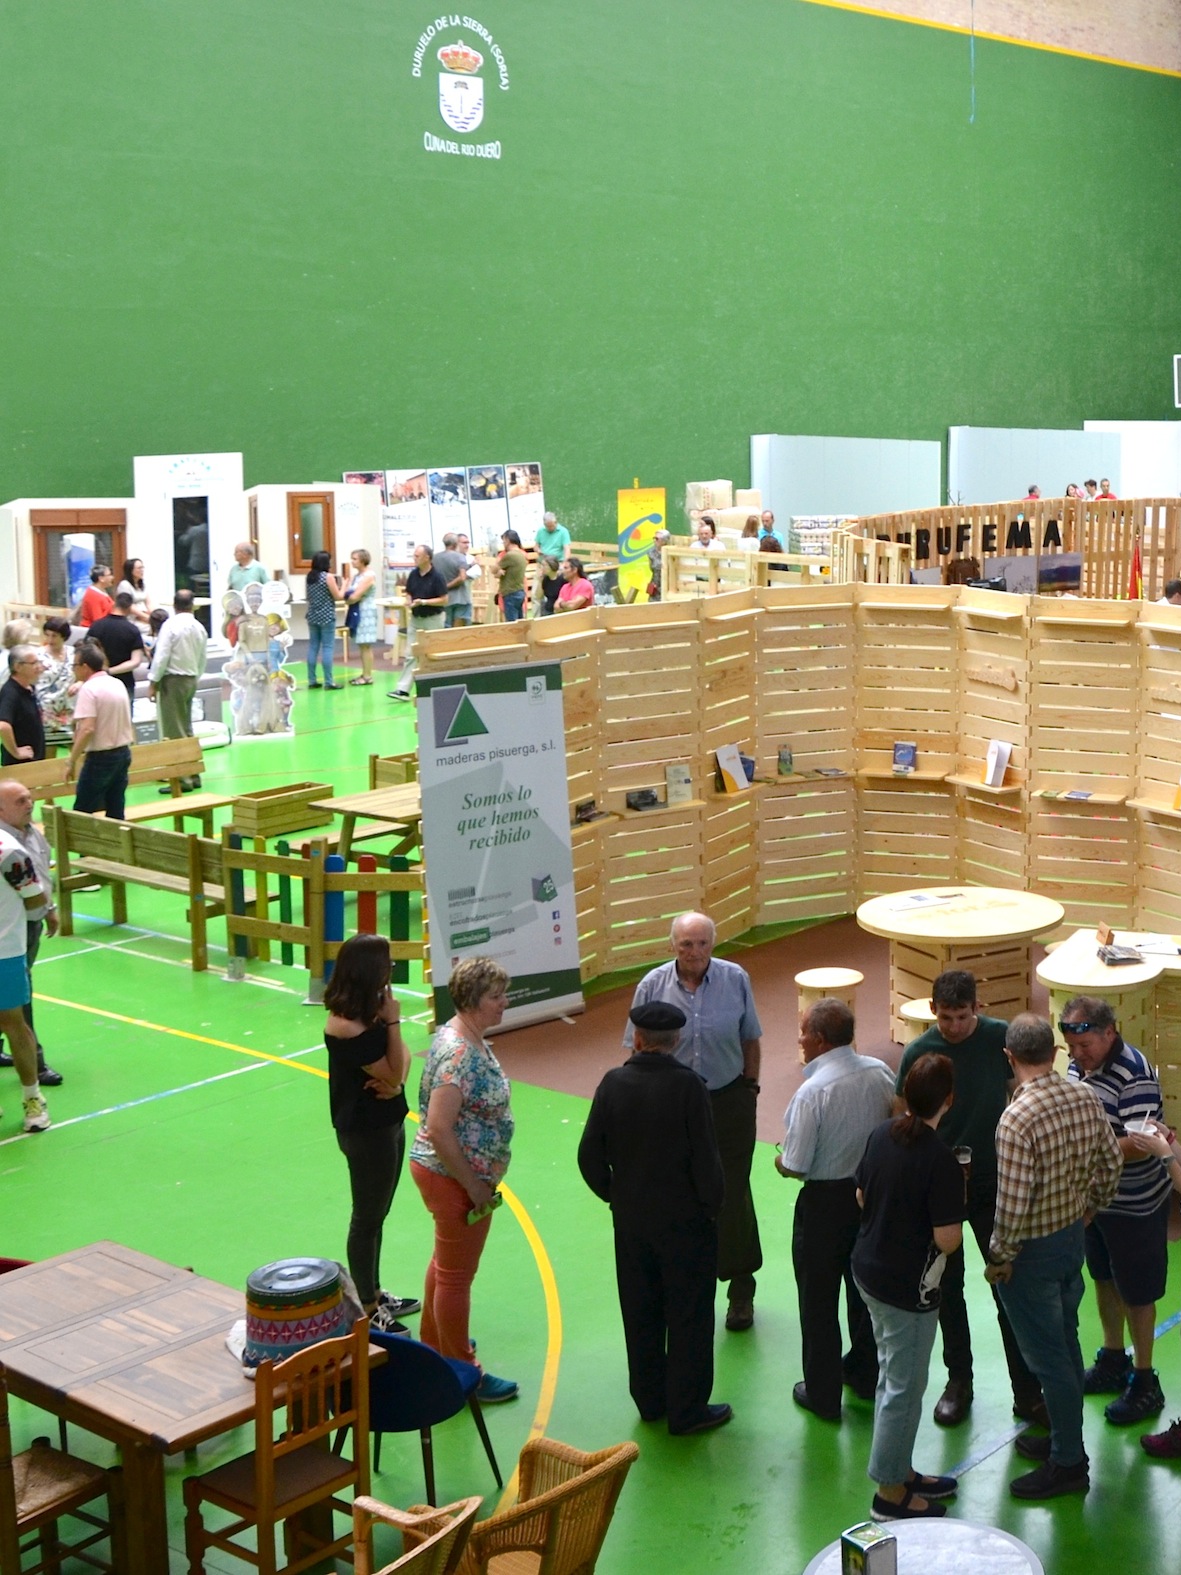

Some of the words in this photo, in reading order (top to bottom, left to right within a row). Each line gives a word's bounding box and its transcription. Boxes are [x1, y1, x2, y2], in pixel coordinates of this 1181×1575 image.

[412, 25, 436, 77] DURUELO
[434, 15, 449, 31] DE
[449, 14, 461, 26] LA
[462, 15, 493, 45] SIERRA
[490, 44, 510, 90] (SORIA)
[424, 131, 446, 153] CUNA
[446, 141, 460, 155] DEL
[461, 143, 475, 156] RIO
[476, 140, 501, 159] DUERO
[436, 751, 486, 767] maderas
[489, 743, 539, 762] pisuerga,
[541, 740, 556, 751] s.l.
[462, 789, 514, 810] Somos
[518, 785, 532, 801] lo
[457, 816, 486, 836] que
[492, 806, 539, 825] hemos
[469, 828, 531, 851] recibido
